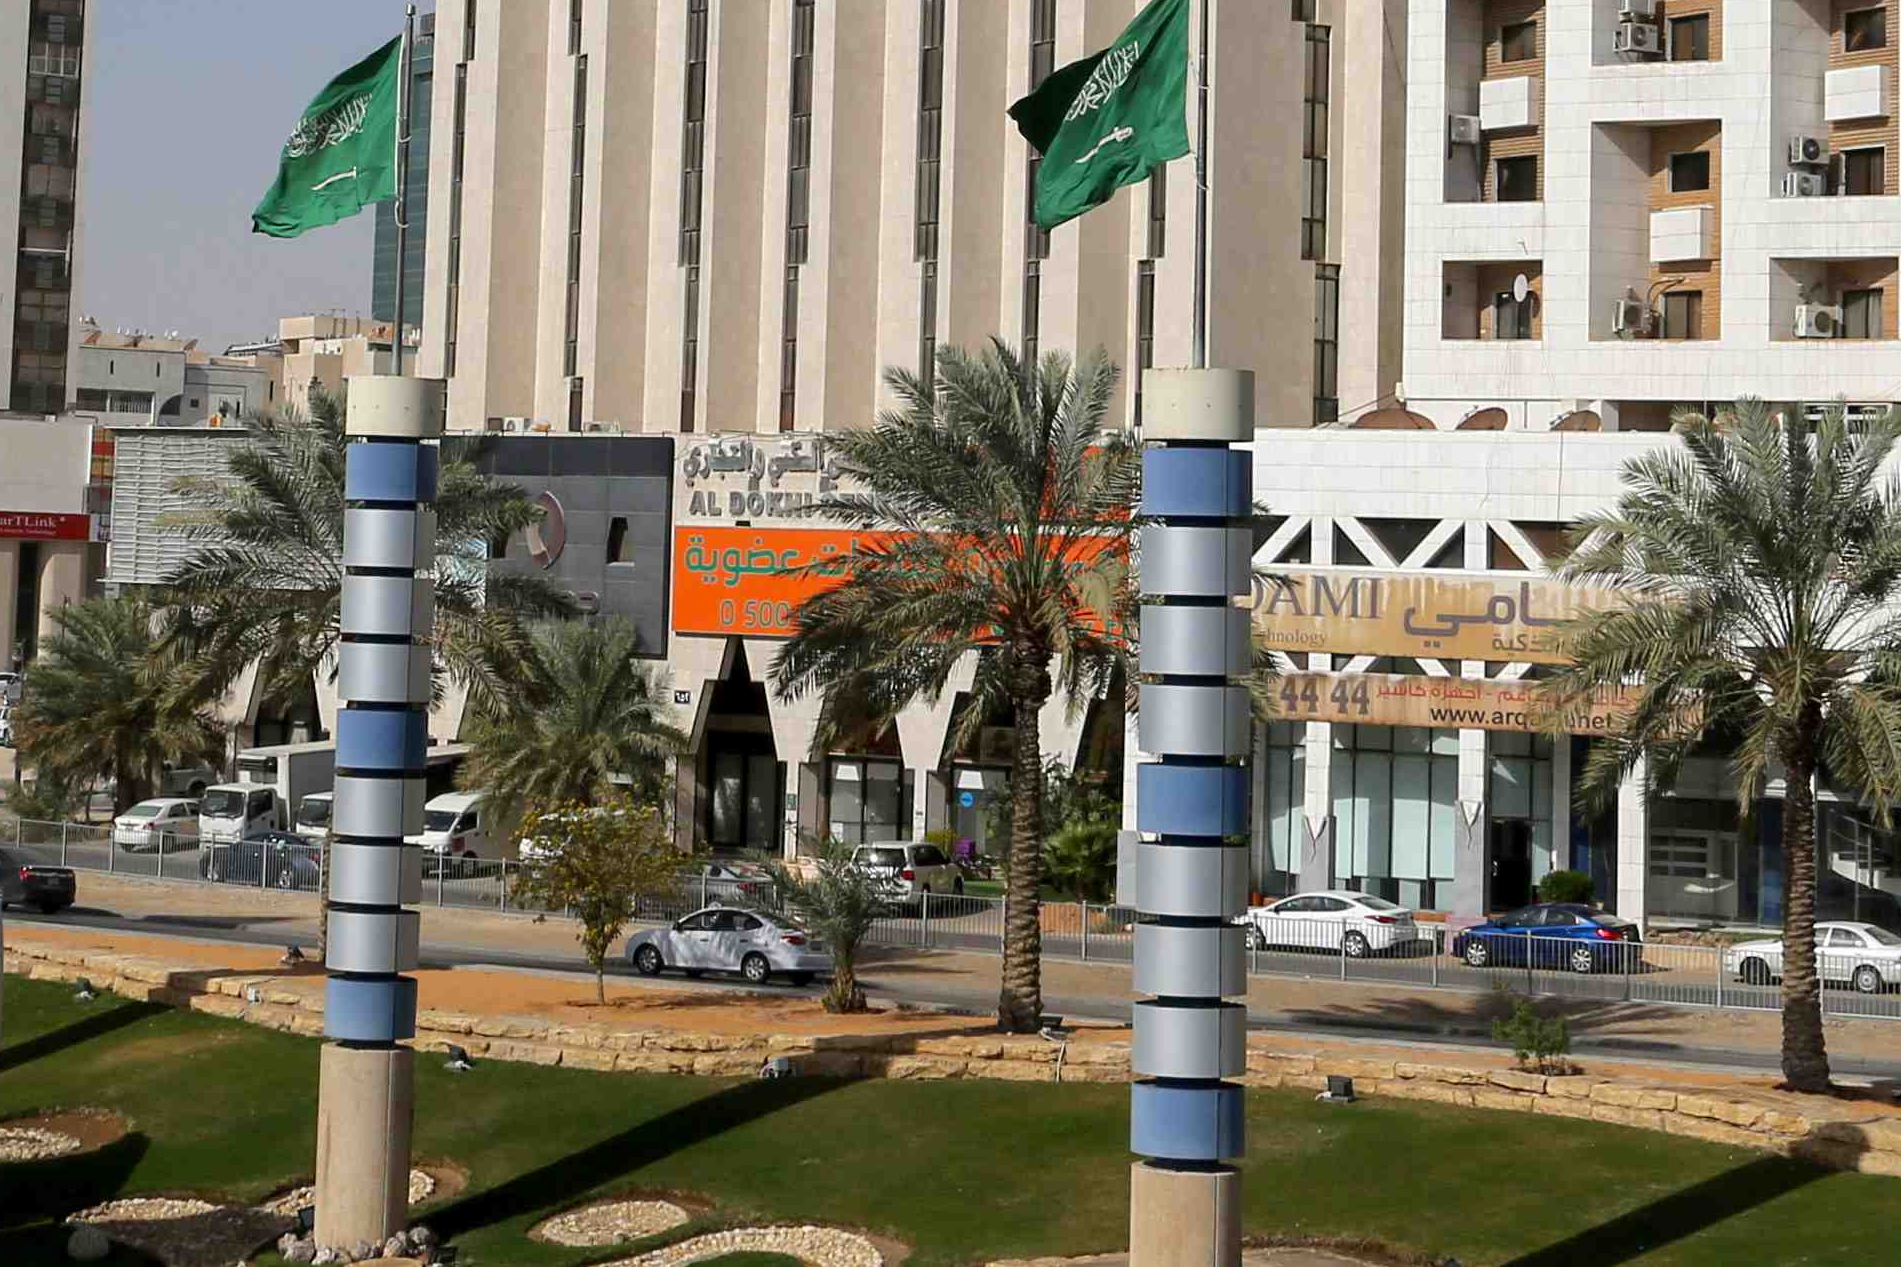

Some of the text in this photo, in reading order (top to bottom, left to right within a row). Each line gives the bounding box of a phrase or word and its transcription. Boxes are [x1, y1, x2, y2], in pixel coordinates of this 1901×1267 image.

[689, 491, 722, 517] AL
[685, 536, 800, 586] عضوية
[1267, 628, 1327, 647] hnology
[1430, 707, 1612, 730] www.arqnet
